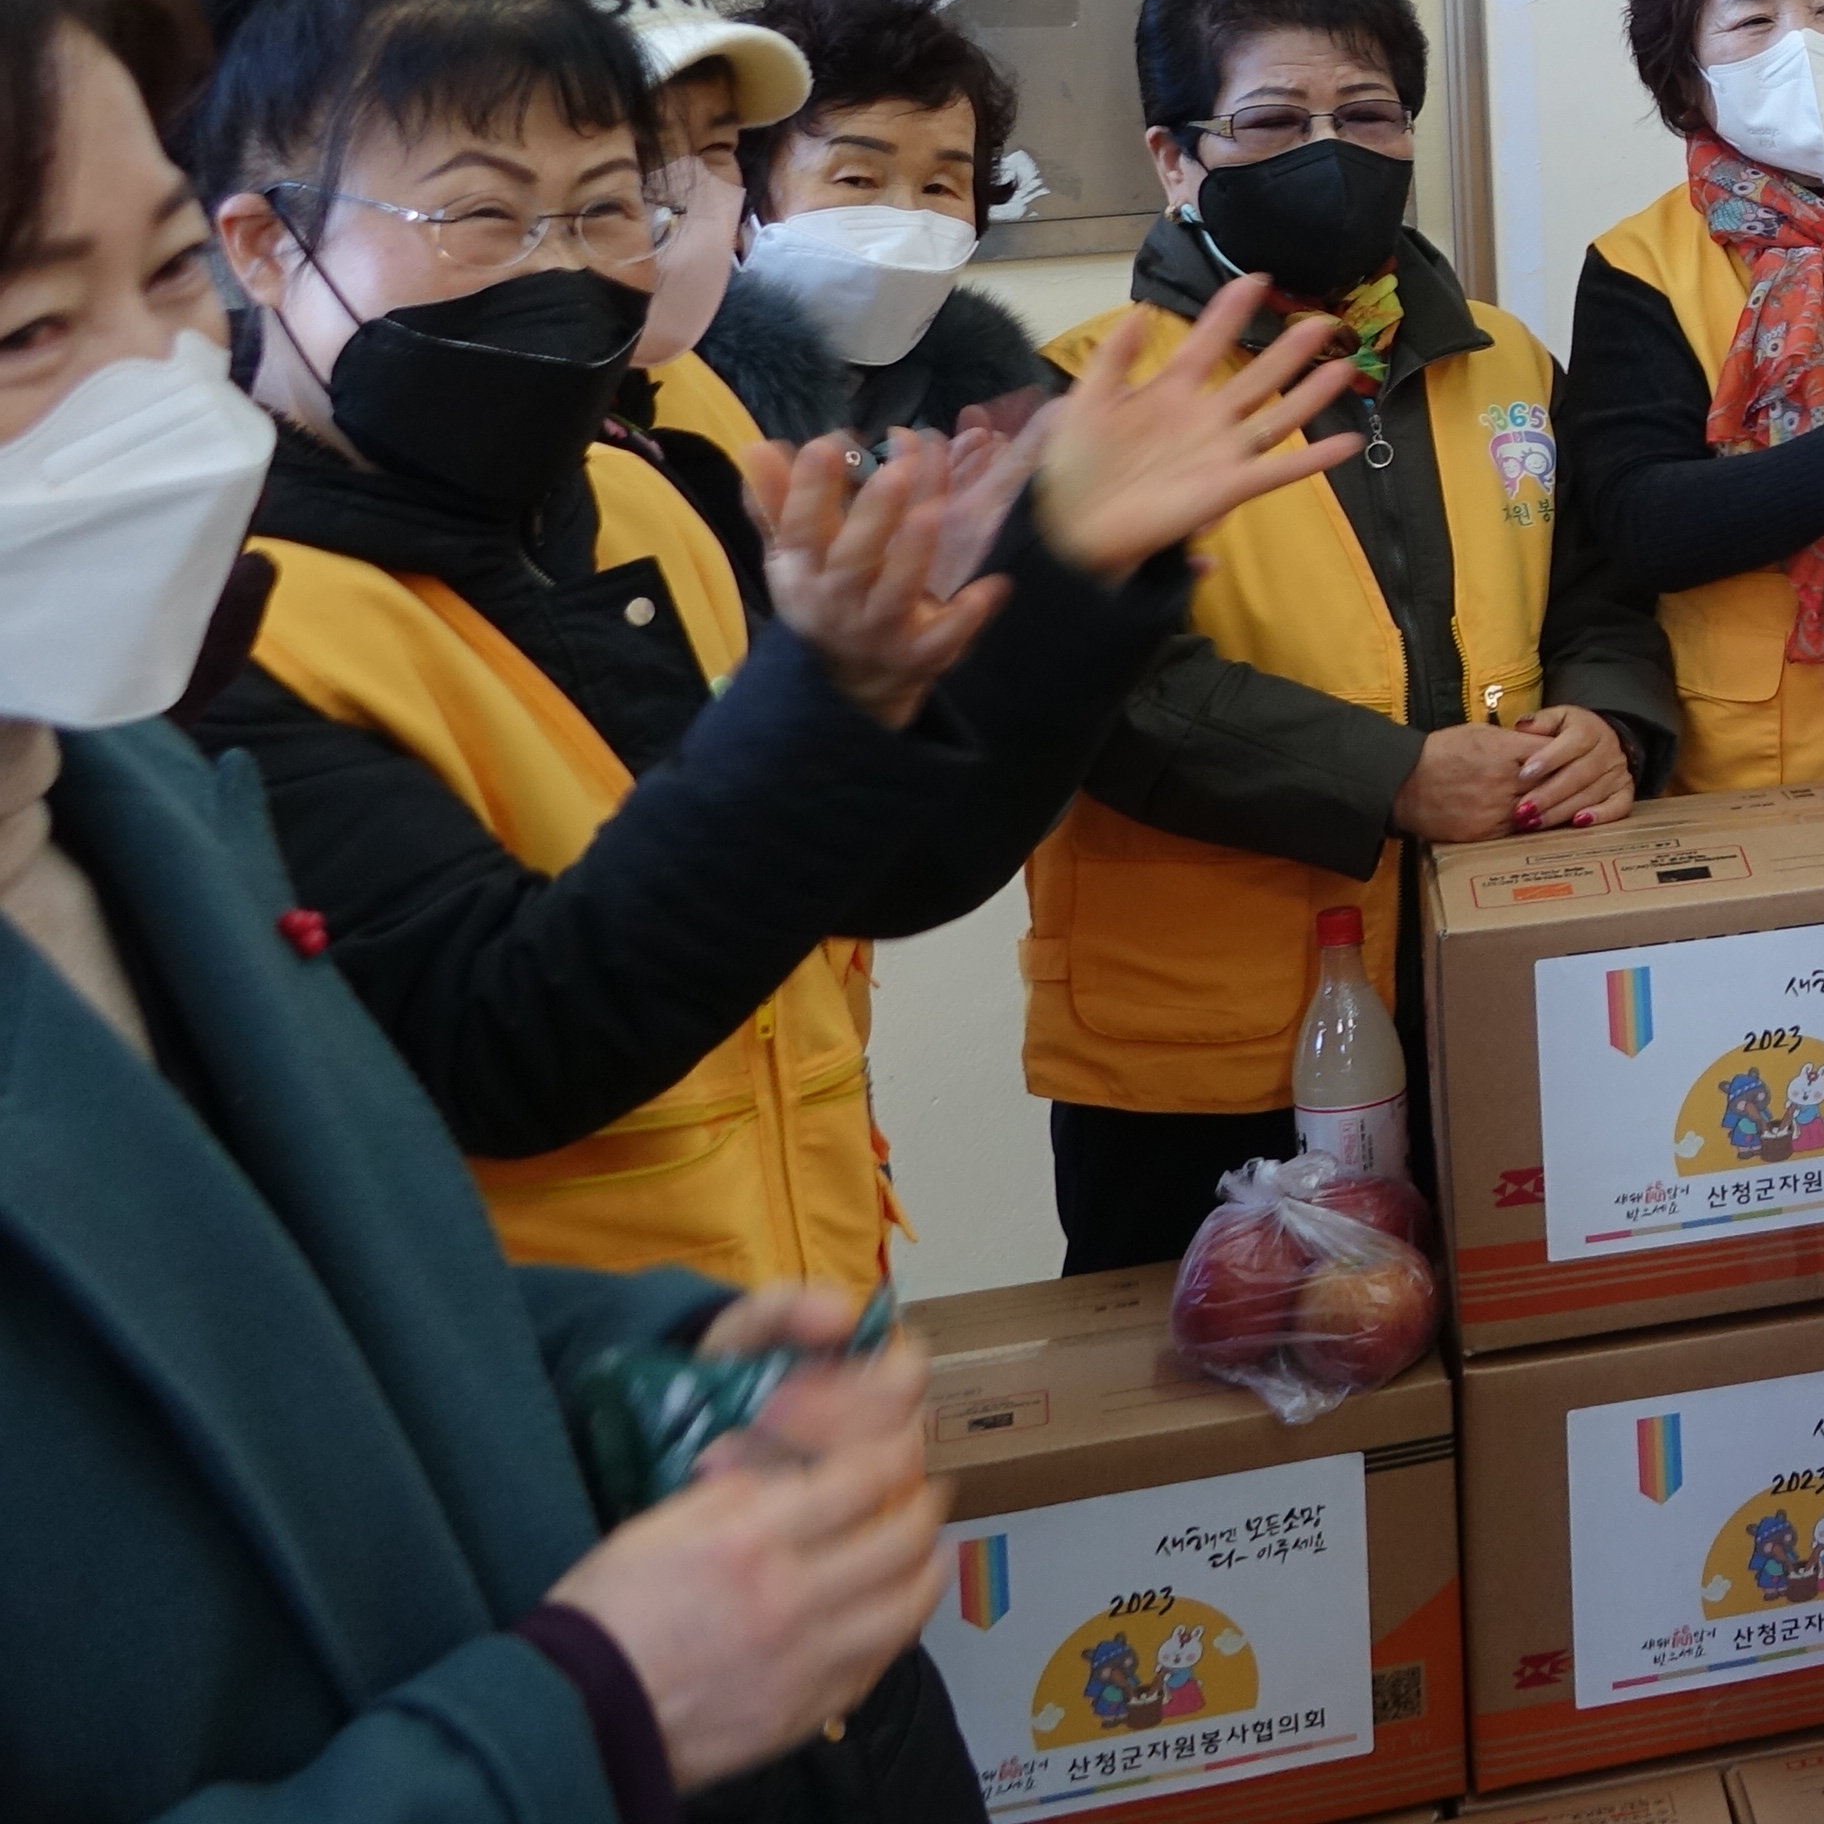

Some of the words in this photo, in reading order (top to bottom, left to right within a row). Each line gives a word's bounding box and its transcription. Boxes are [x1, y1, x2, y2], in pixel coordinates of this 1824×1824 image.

[1743, 1025, 1803, 1055] 2023
[1108, 1585, 1176, 1618] 2023
[1067, 1707, 1327, 1783] 산청군자원봉사협의회
